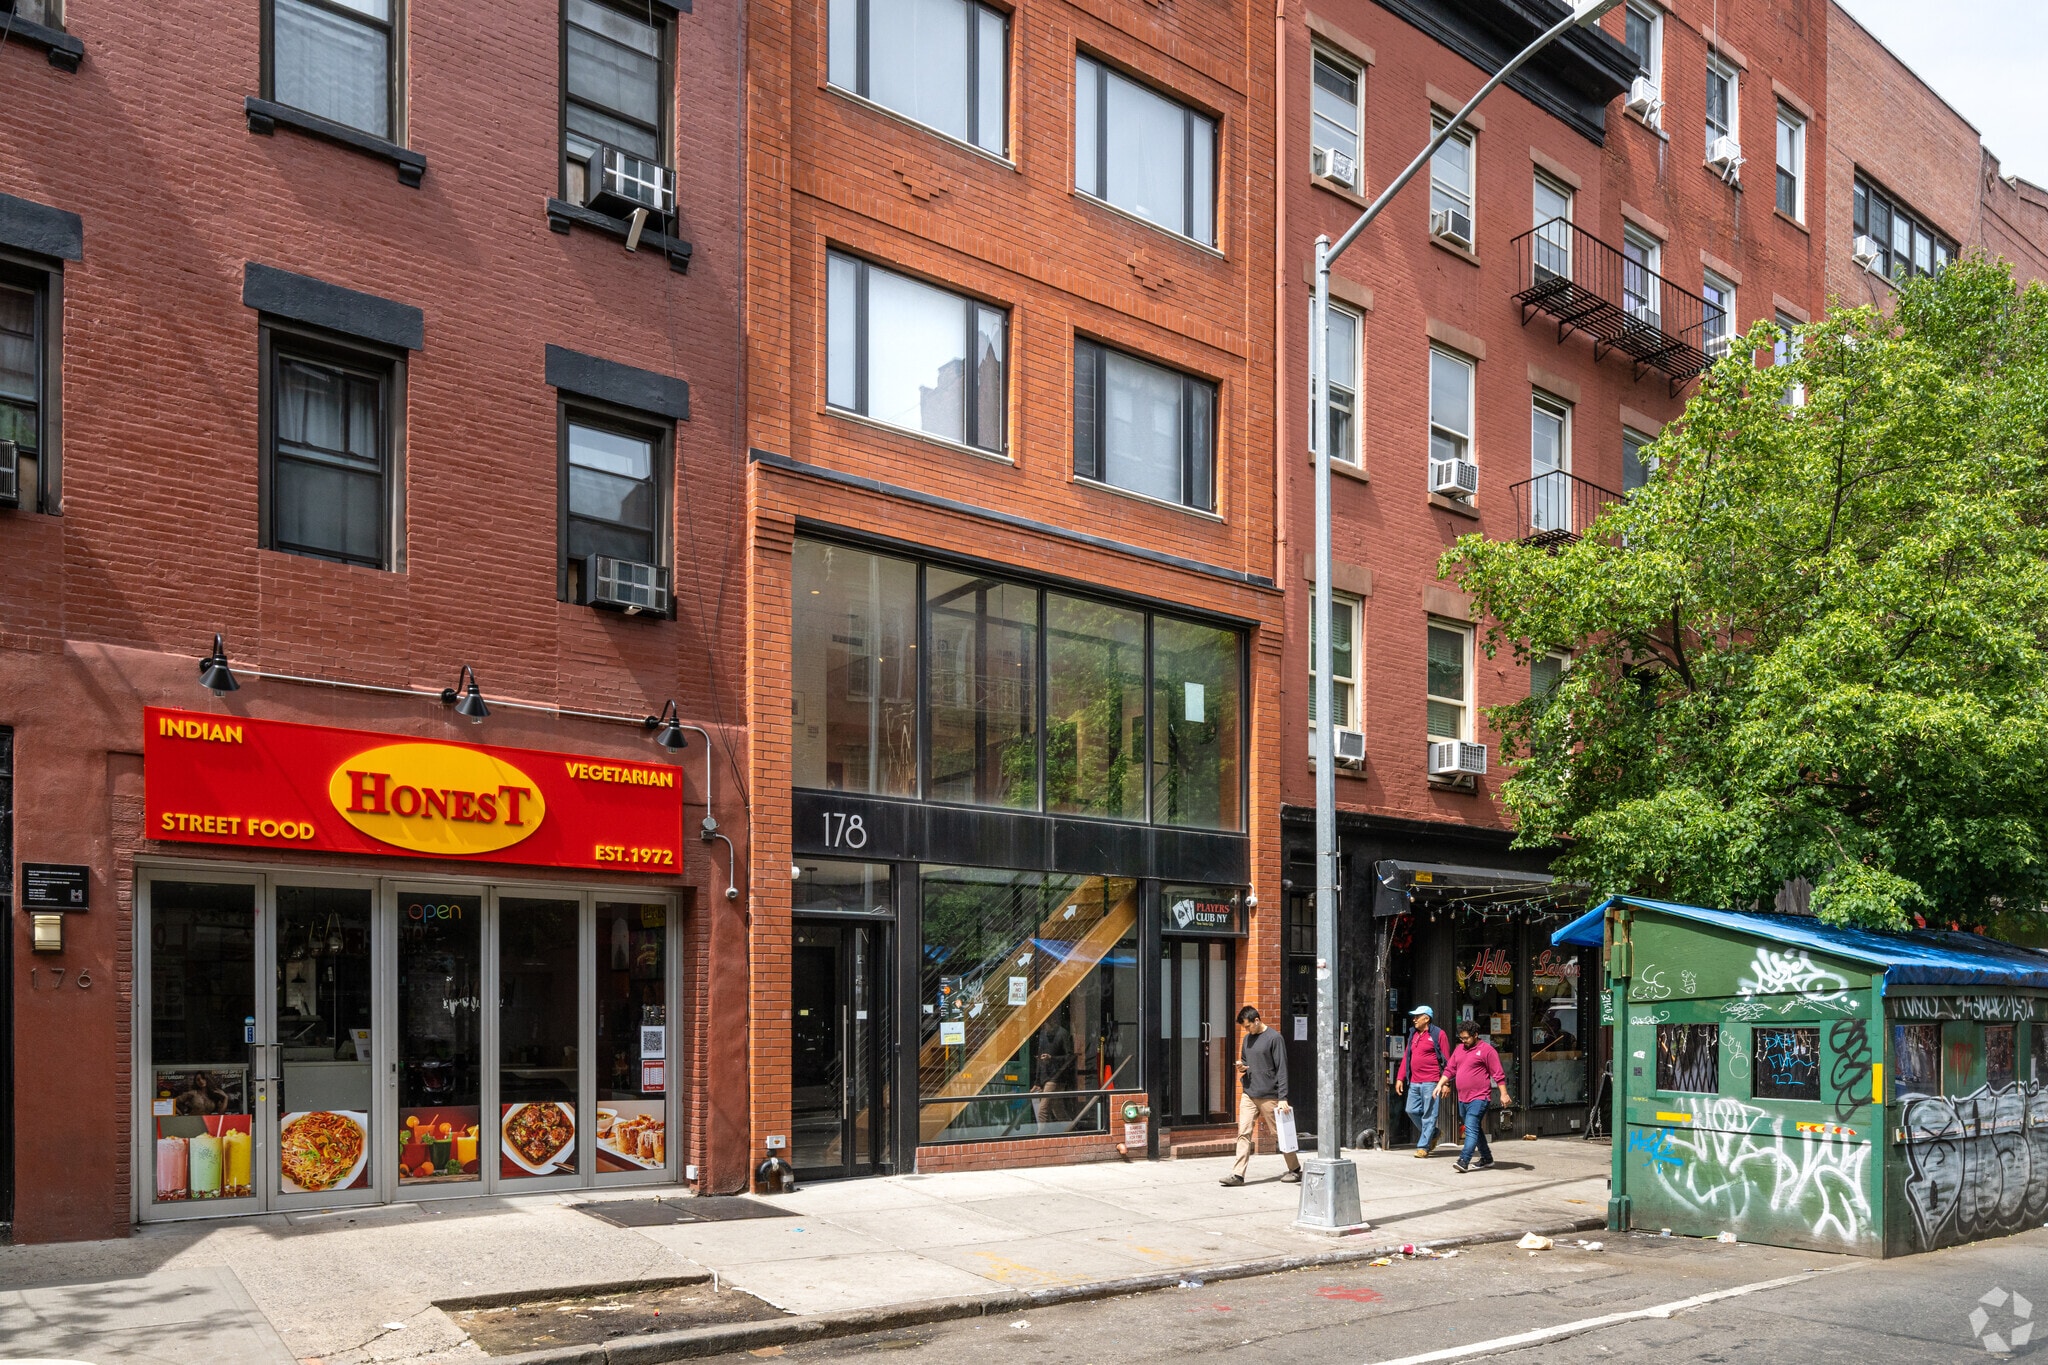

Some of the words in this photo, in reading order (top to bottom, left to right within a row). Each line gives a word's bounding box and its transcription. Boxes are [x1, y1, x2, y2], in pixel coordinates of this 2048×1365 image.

[159, 717, 243, 743] INDIAN
[565, 762, 673, 788] VEGETARIAN
[346, 769, 531, 826] HONEST
[161, 812, 241, 835] STREET
[248, 818, 315, 840] FOOD
[822, 811, 867, 849] 178
[595, 844, 673, 865] EST.1972
[408, 903, 462, 924] open
[1196, 903, 1230, 913] PLAYERS
[1196, 912, 1215, 922] CLUB
[1216, 914, 1227, 923] NY
[1456, 947, 1512, 982] Hello
[1532, 949, 1581, 983] Saigon
[31, 967, 93, 990] 176
[1464, 1008, 1472, 1020] A
[1771, 1072, 1806, 1085] 22
